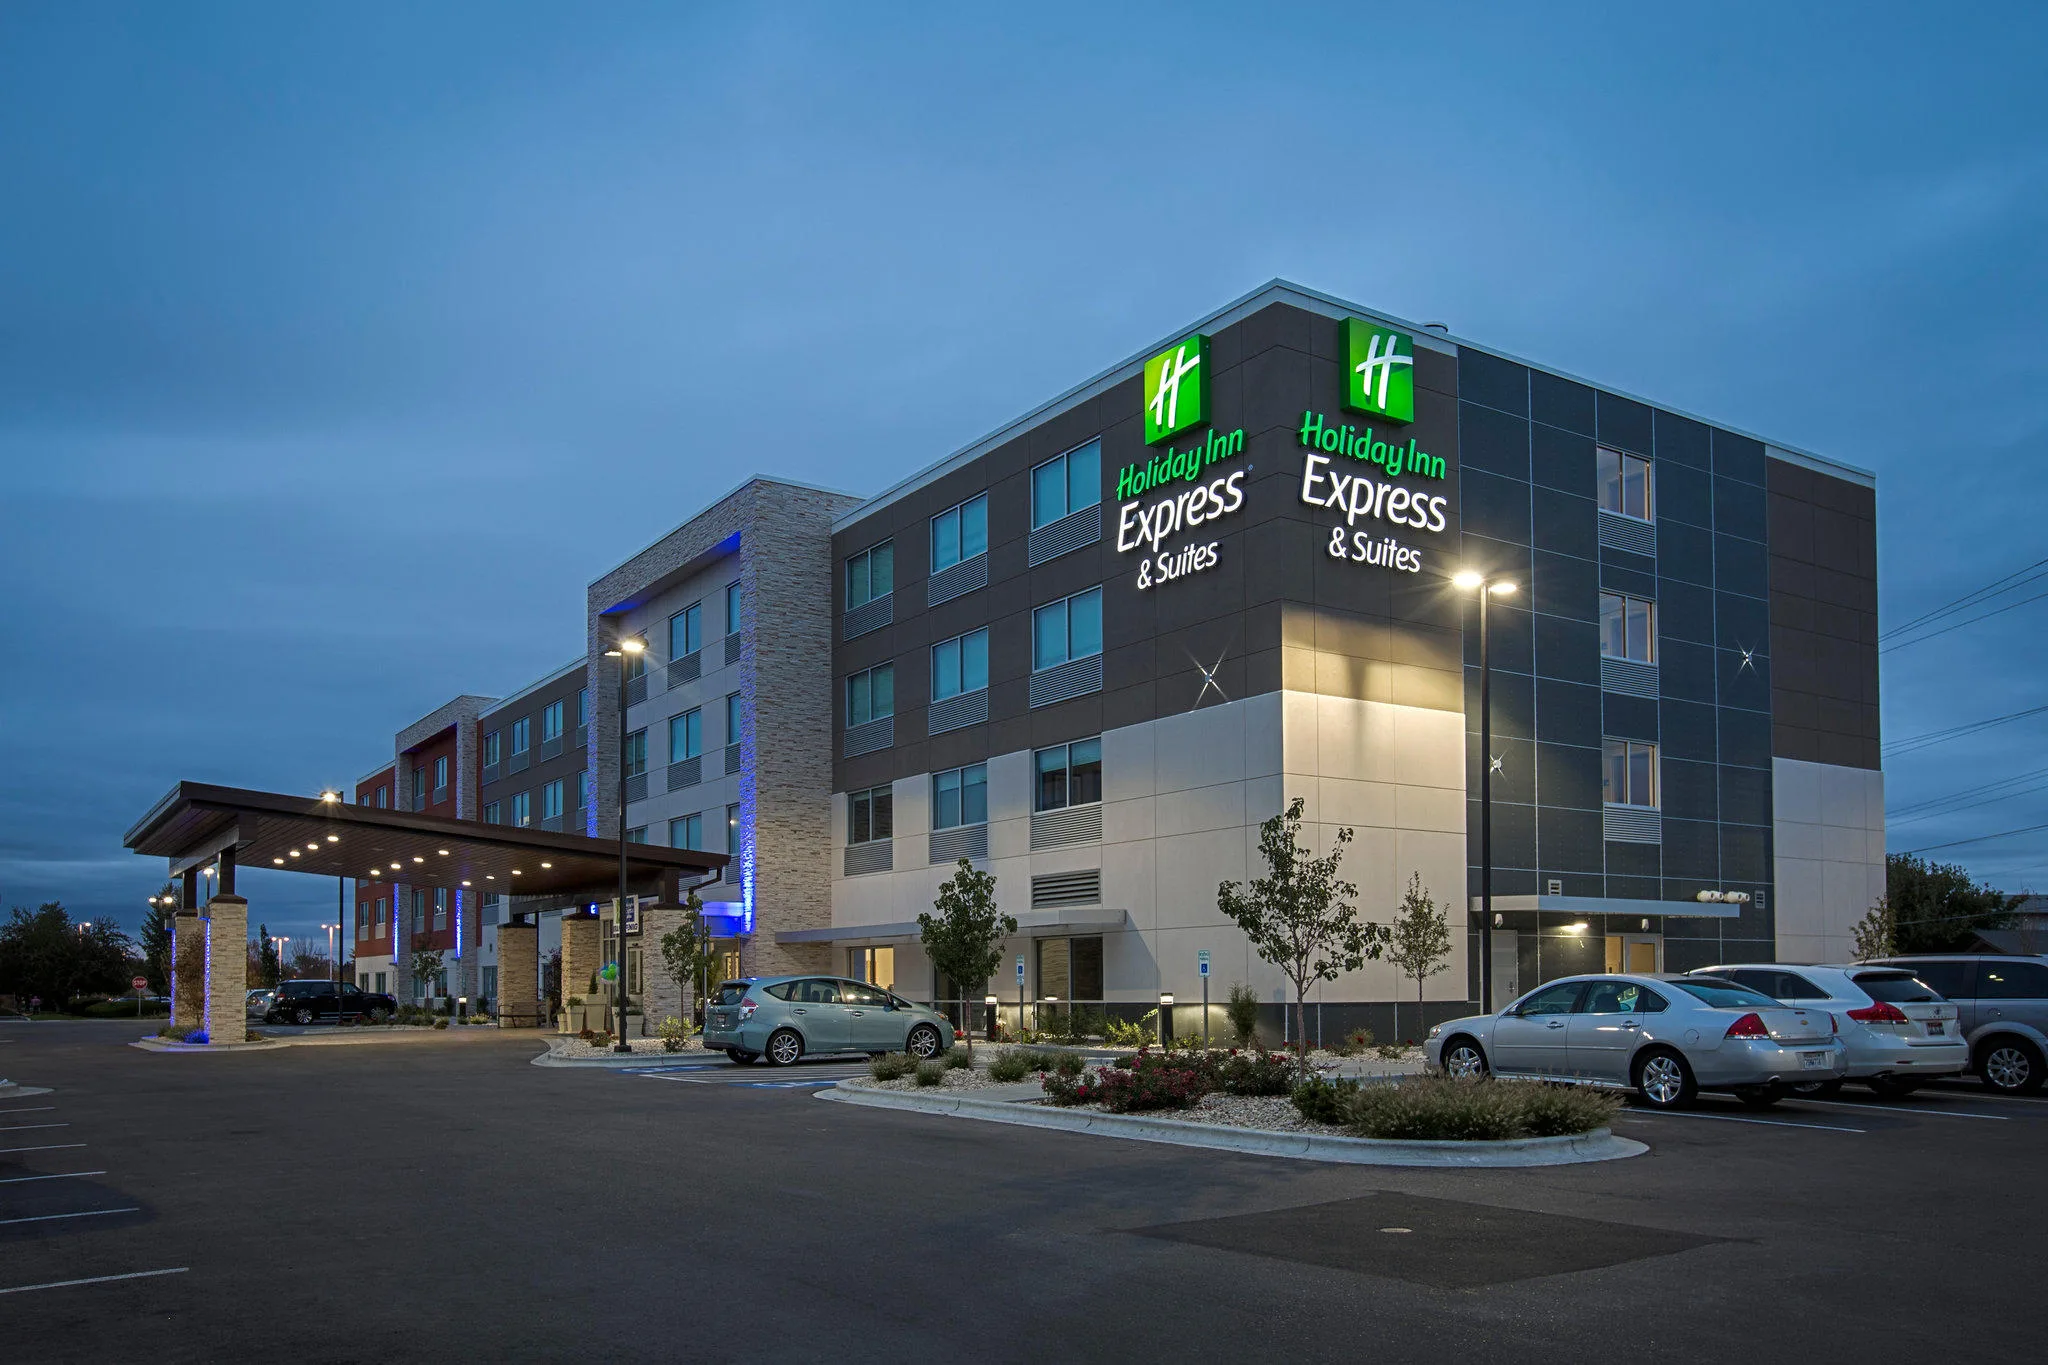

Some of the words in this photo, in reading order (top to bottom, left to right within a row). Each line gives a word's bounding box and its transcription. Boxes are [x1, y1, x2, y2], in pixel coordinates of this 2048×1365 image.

[1116, 445, 1203, 501] Holiday
[1205, 428, 1244, 465] Inn
[1300, 410, 1405, 477] Holiday
[1407, 438, 1446, 480] Inn
[1117, 470, 1244, 553] Express
[1302, 453, 1448, 533] Express
[1136, 558, 1152, 590] &
[1155, 541, 1218, 584] Suites
[1328, 526, 1347, 559] &
[1352, 531, 1422, 573] Suites
